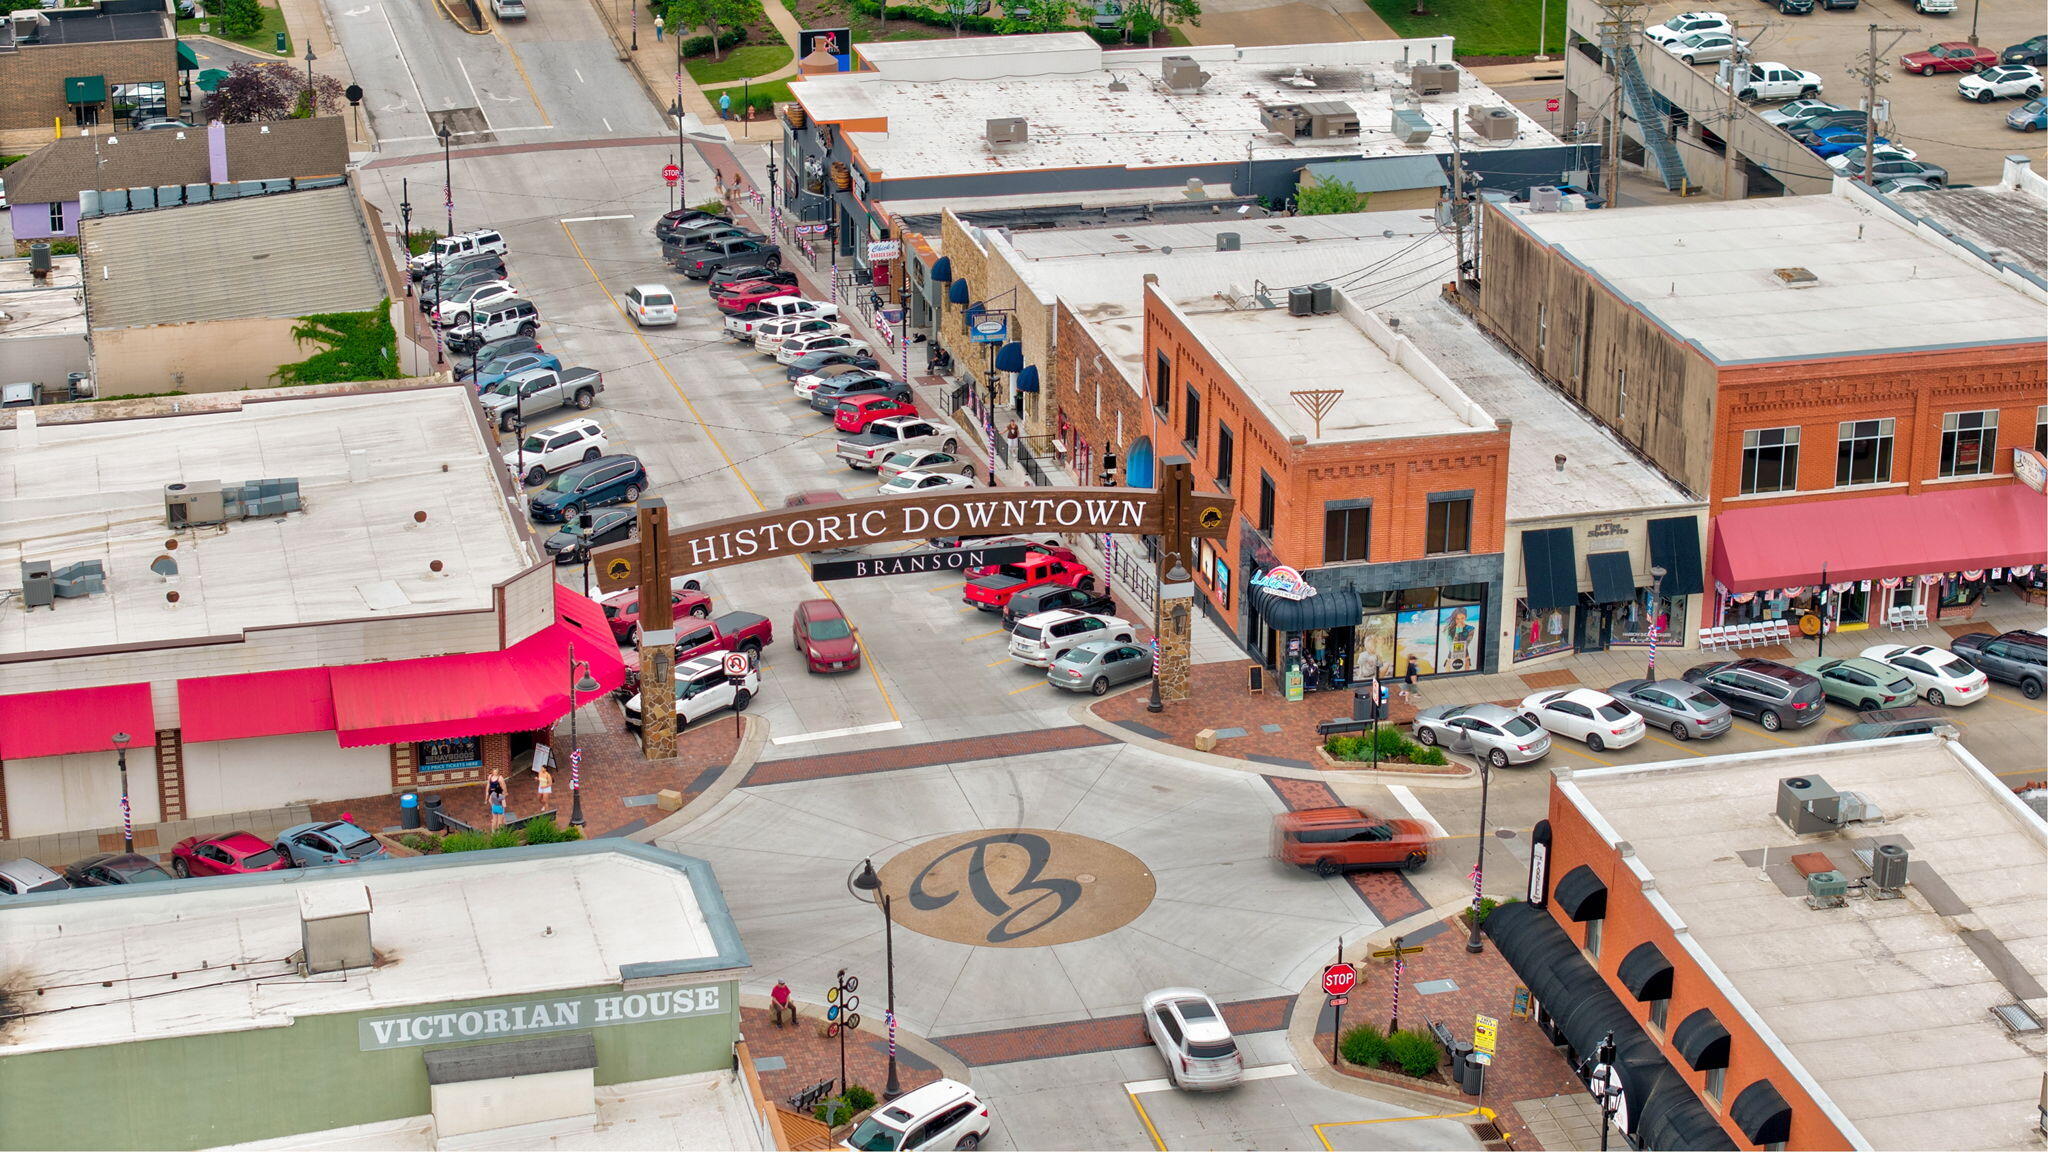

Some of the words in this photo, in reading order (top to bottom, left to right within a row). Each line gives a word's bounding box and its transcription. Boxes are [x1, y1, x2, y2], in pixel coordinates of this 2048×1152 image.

[688, 510, 888, 566] HISTORIC
[902, 499, 1147, 534] DOWNTOWN
[856, 550, 985, 577] BRANSON
[1325, 973, 1353, 986] STOP
[370, 1001, 581, 1045] VICTORIAN
[594, 987, 720, 1022] HOUSE
